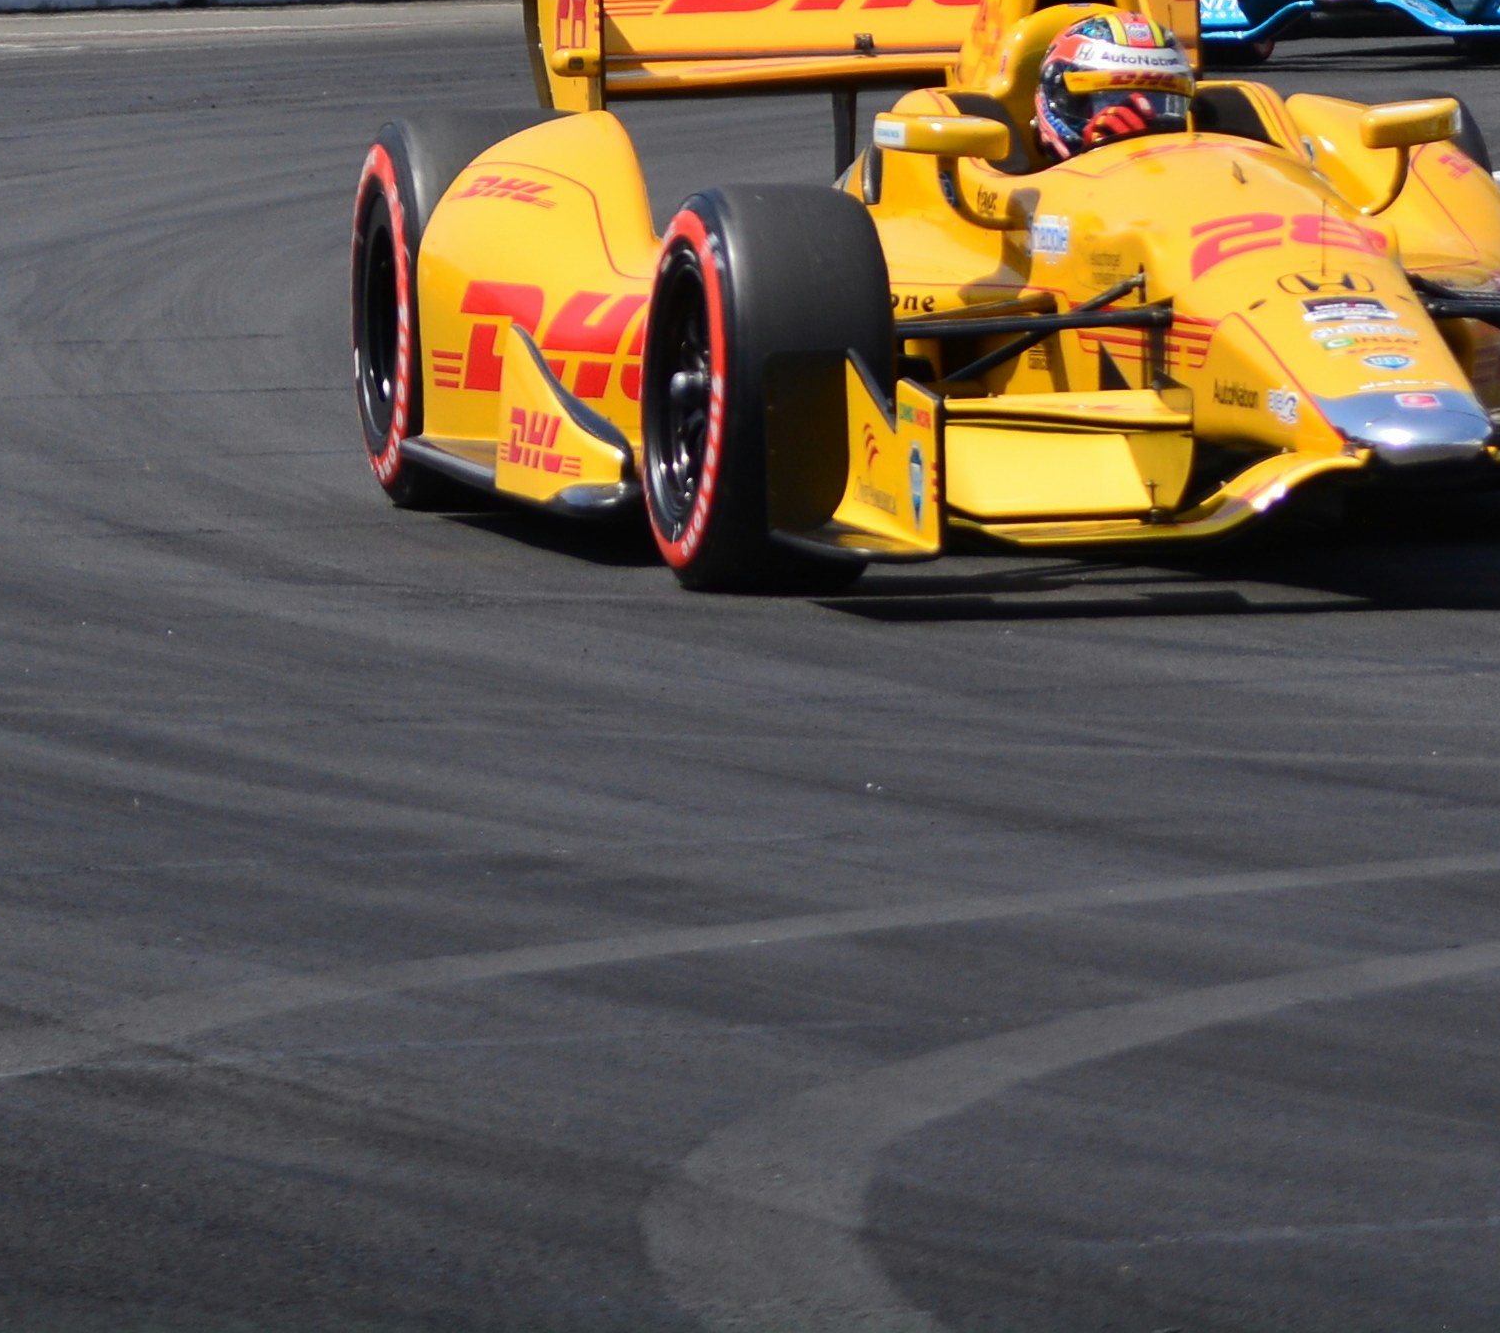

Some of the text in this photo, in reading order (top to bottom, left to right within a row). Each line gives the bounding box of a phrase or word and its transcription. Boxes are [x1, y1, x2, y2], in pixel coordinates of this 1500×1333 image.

[453, 175, 553, 204] DHL
[1190, 212, 1388, 282] 28
[510, 406, 564, 474] DHL
